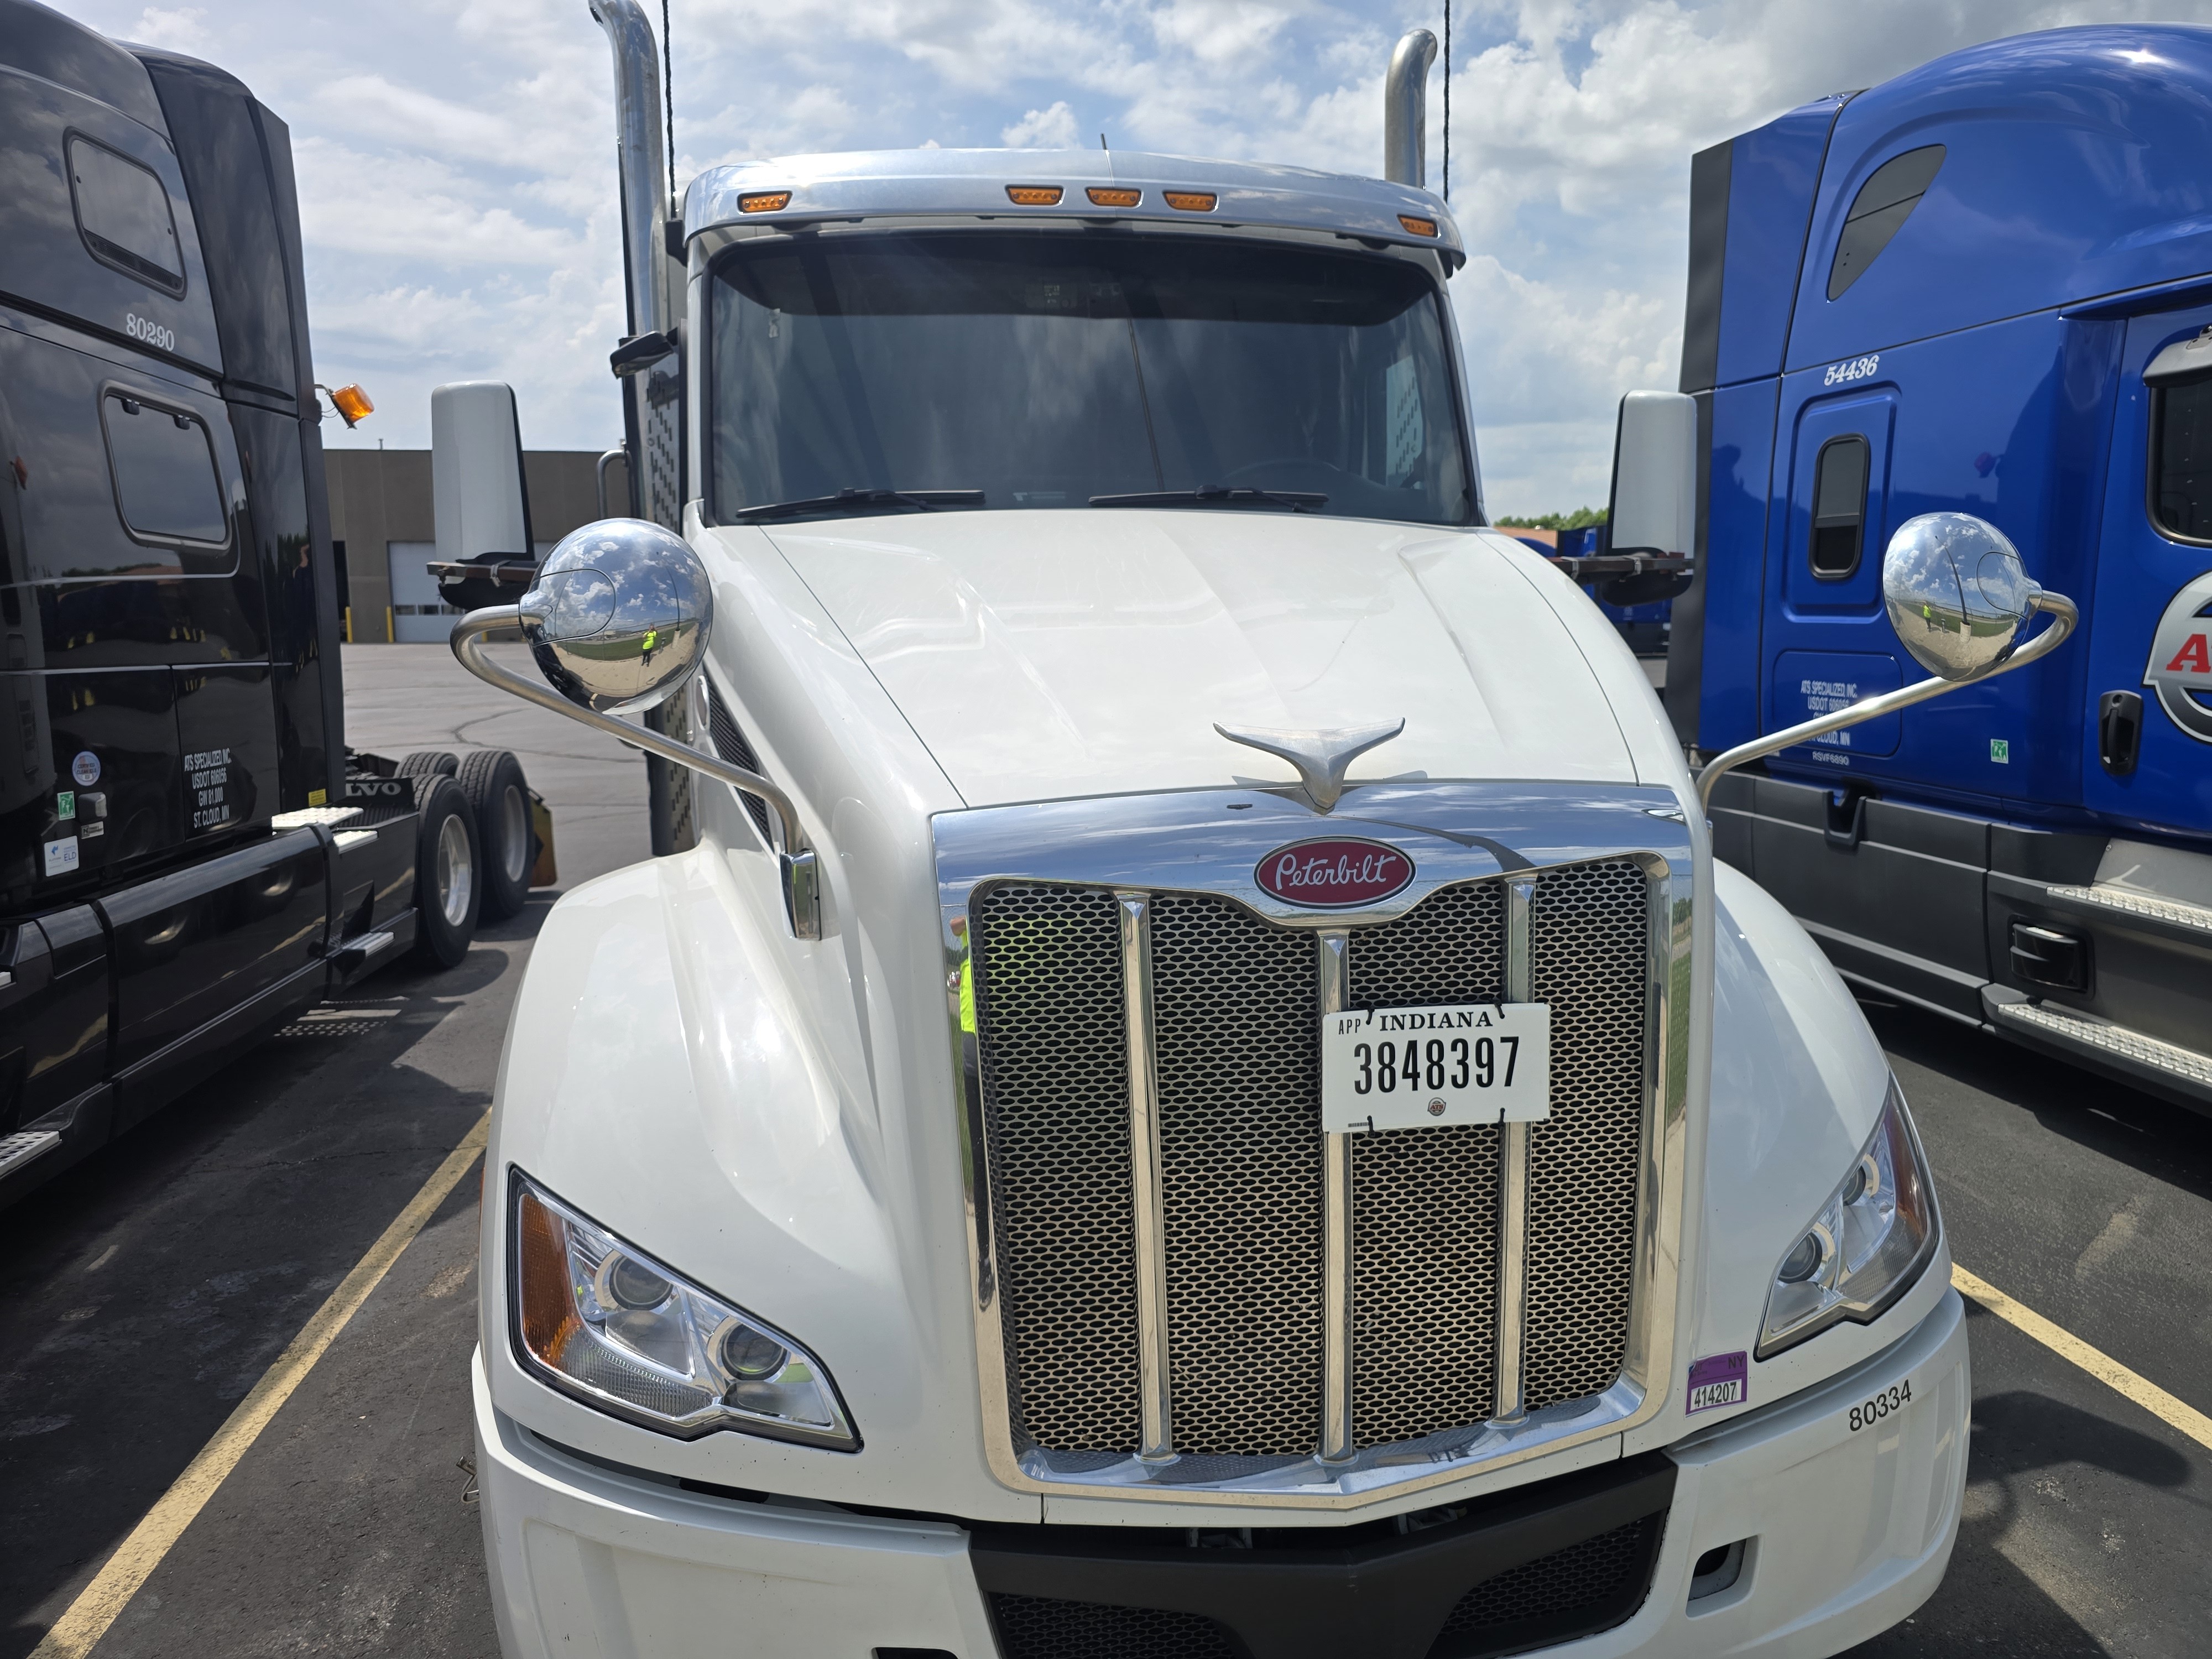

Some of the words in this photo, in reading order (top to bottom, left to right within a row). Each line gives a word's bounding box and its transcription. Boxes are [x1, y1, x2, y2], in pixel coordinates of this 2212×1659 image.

[126, 312, 175, 352] 80290
[1824, 354, 1880, 386] 54436
[2166, 633, 2212, 674] A
[1801, 680, 1811, 694] ATS
[1807, 696, 1828, 711] USDOT
[1839, 731, 1851, 746] MN
[185, 754, 194, 771] ATS
[192, 770, 210, 790] USDOT
[199, 790, 208, 807] GW
[194, 811, 202, 828] ST.
[221, 804, 229, 821] MN
[64, 851, 77, 861] ELD
[1275, 853, 1397, 891] Peterbilt
[1338, 1018, 1361, 1035] APP
[1379, 1011, 1493, 1031] INDIANA
[1353, 1036, 1520, 1095] 3848397
[1728, 1354, 1745, 1369] NY
[1694, 1381, 1737, 1408] 414207
[1849, 1379, 1912, 1432] 80334
